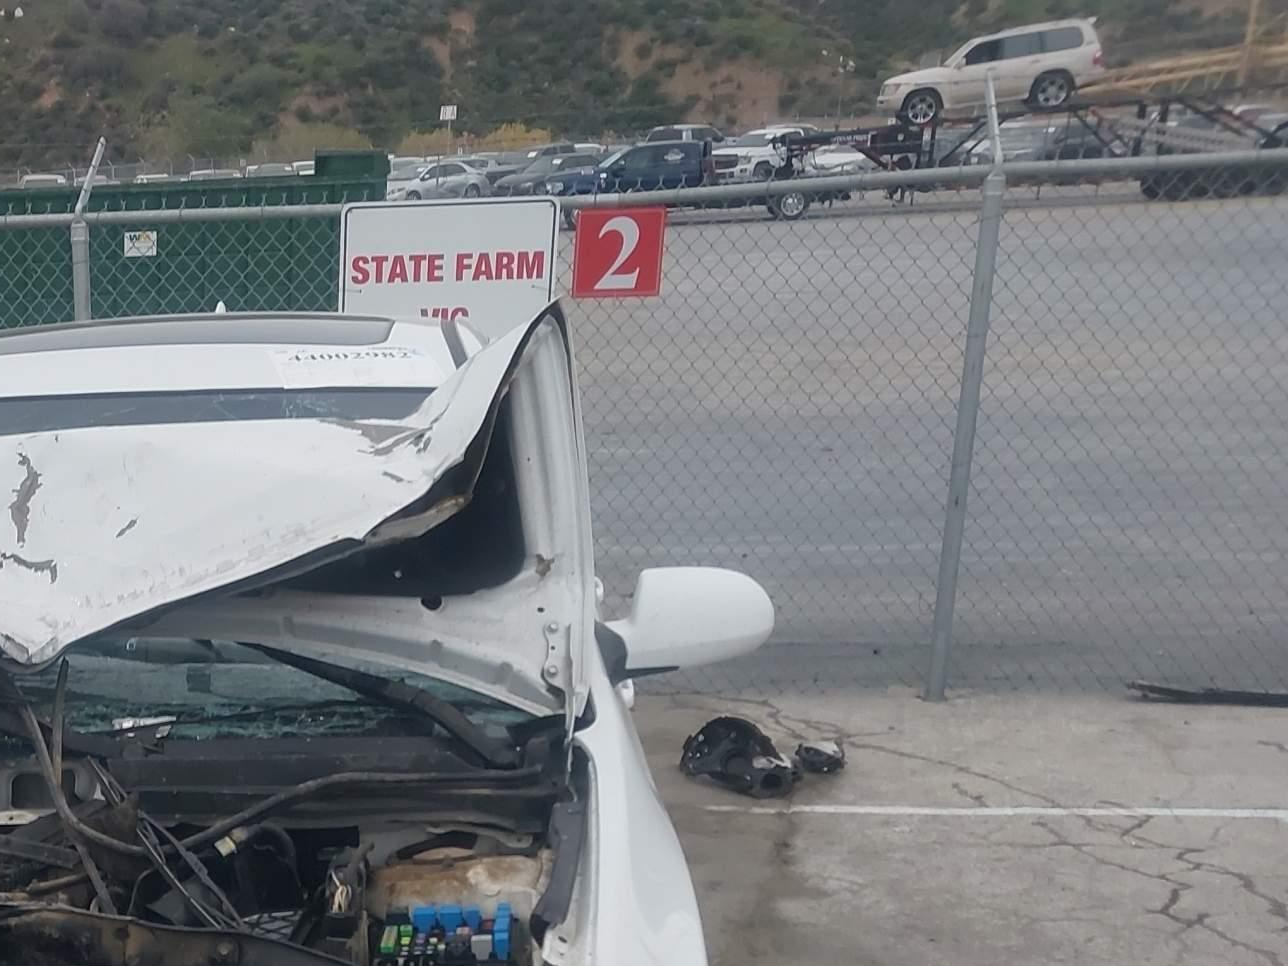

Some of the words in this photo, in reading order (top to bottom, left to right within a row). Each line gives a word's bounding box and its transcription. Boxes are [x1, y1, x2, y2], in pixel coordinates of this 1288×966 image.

[351, 254, 444, 284] STATE
[455, 251, 545, 281] FARM
[594, 216, 640, 289] 2
